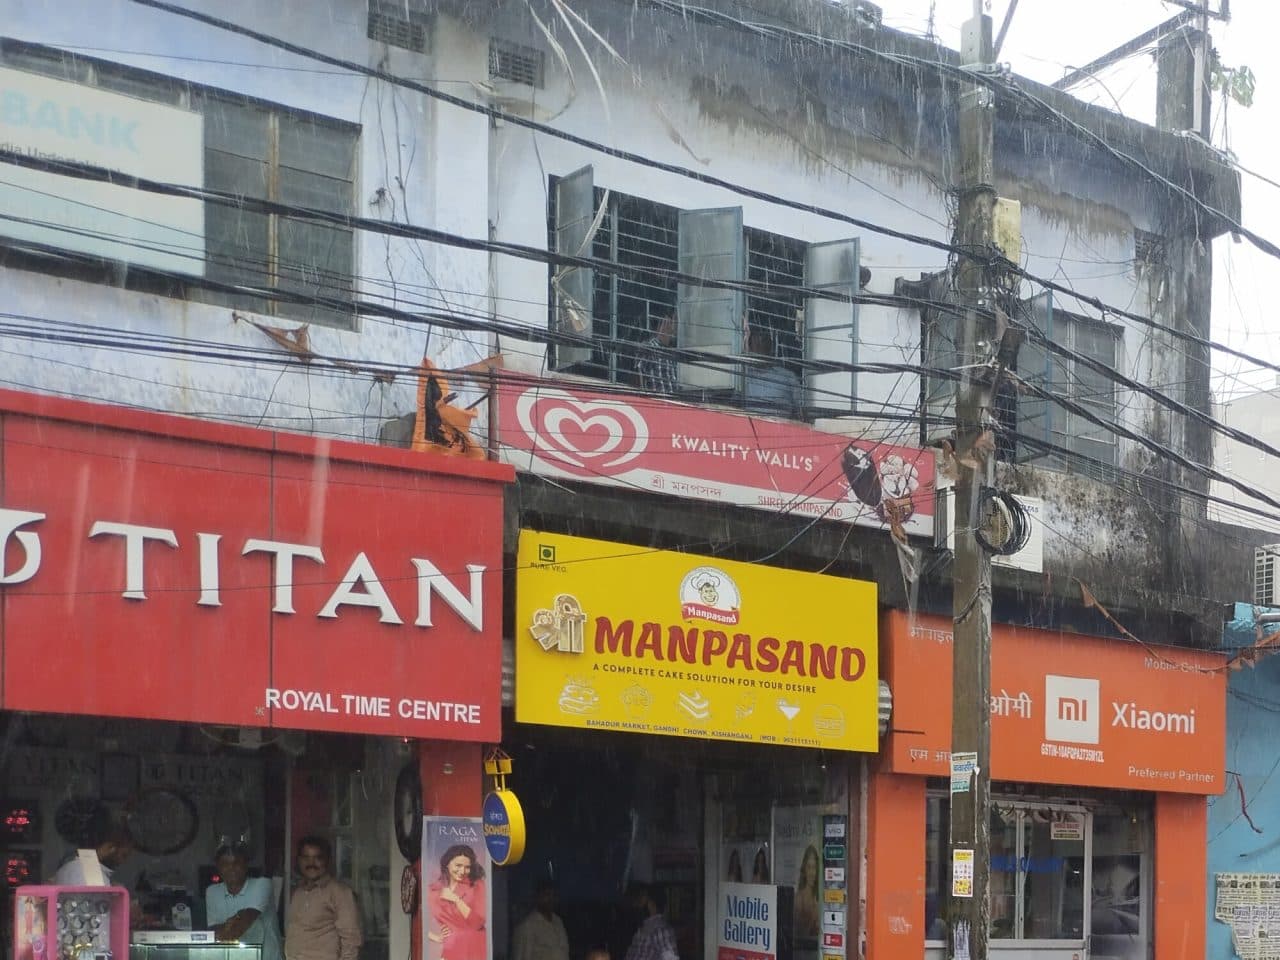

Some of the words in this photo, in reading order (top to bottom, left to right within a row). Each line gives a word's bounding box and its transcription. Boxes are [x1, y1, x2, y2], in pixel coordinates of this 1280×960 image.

[2, 89, 141, 155] BANK
[671, 433, 750, 461] KWALITY
[756, 450, 813, 472] WALL'S
[758, 495, 786, 510] SHREE
[88, 519, 487, 633] TITAN
[687, 606, 737, 623] Manpasand
[594, 615, 867, 683] MANPASAND
[593, 663, 600, 671] A
[602, 664, 656, 677] COMPLETE
[658, 669, 684, 680] CAKE
[686, 673, 735, 685] SOLUTION
[738, 678, 756, 688] FOR
[758, 680, 783, 691] YOUR
[785, 683, 817, 694] DESIRE
[265, 688, 339, 714] ROYAL
[341, 693, 390, 718] TIME
[398, 699, 482, 725] CENTRE
[1111, 701, 1196, 735] Xiaomi
[586, 719, 620, 728] BAHADUR
[622, 722, 651, 731] MARKET
[683, 728, 708, 736] CHOWK
[1128, 765, 1176, 780] Preferred
[1178, 770, 1216, 783] Partner
[438, 825, 477, 837] RAGA
[727, 894, 769, 921] Mobile
[724, 919, 770, 951] Gallery
